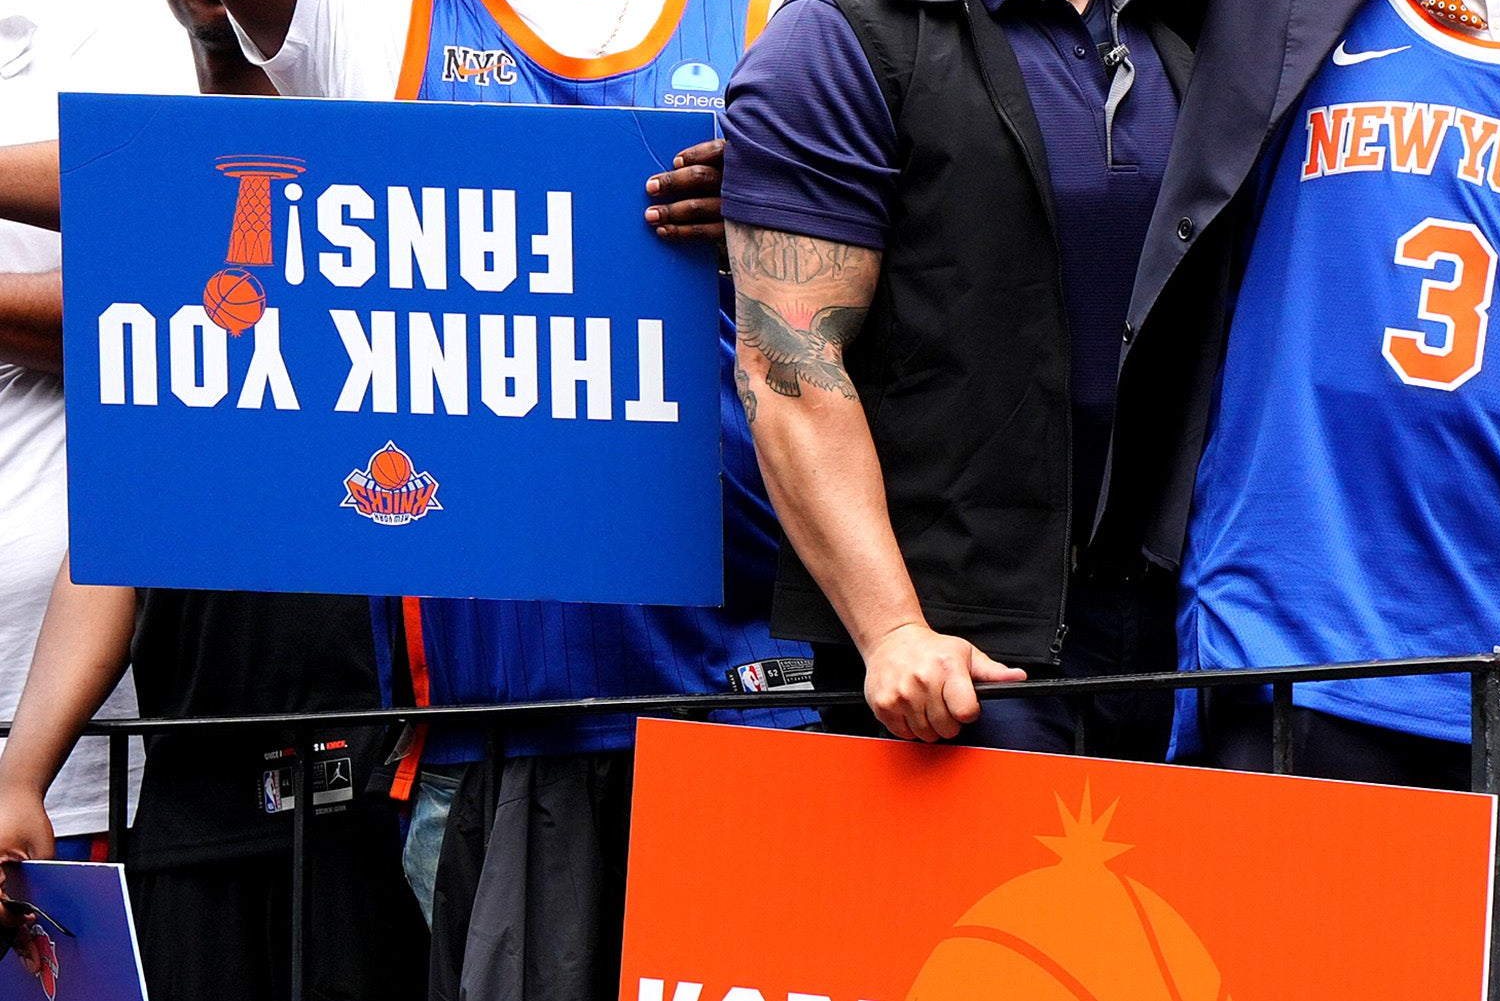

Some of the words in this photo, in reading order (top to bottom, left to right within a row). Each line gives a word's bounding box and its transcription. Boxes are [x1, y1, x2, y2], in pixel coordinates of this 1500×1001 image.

[442, 46, 518, 86] NYC
[664, 93, 726, 107] sphere
[1300, 101, 1456, 182] NEW
[284, 182, 575, 294] FANS!
[1382, 217, 1498, 392] 3
[99, 303, 301, 410] YOU
[329, 309, 679, 422] THANK
[347, 480, 435, 516] KNICKS
[767, 669, 779, 677] 52
